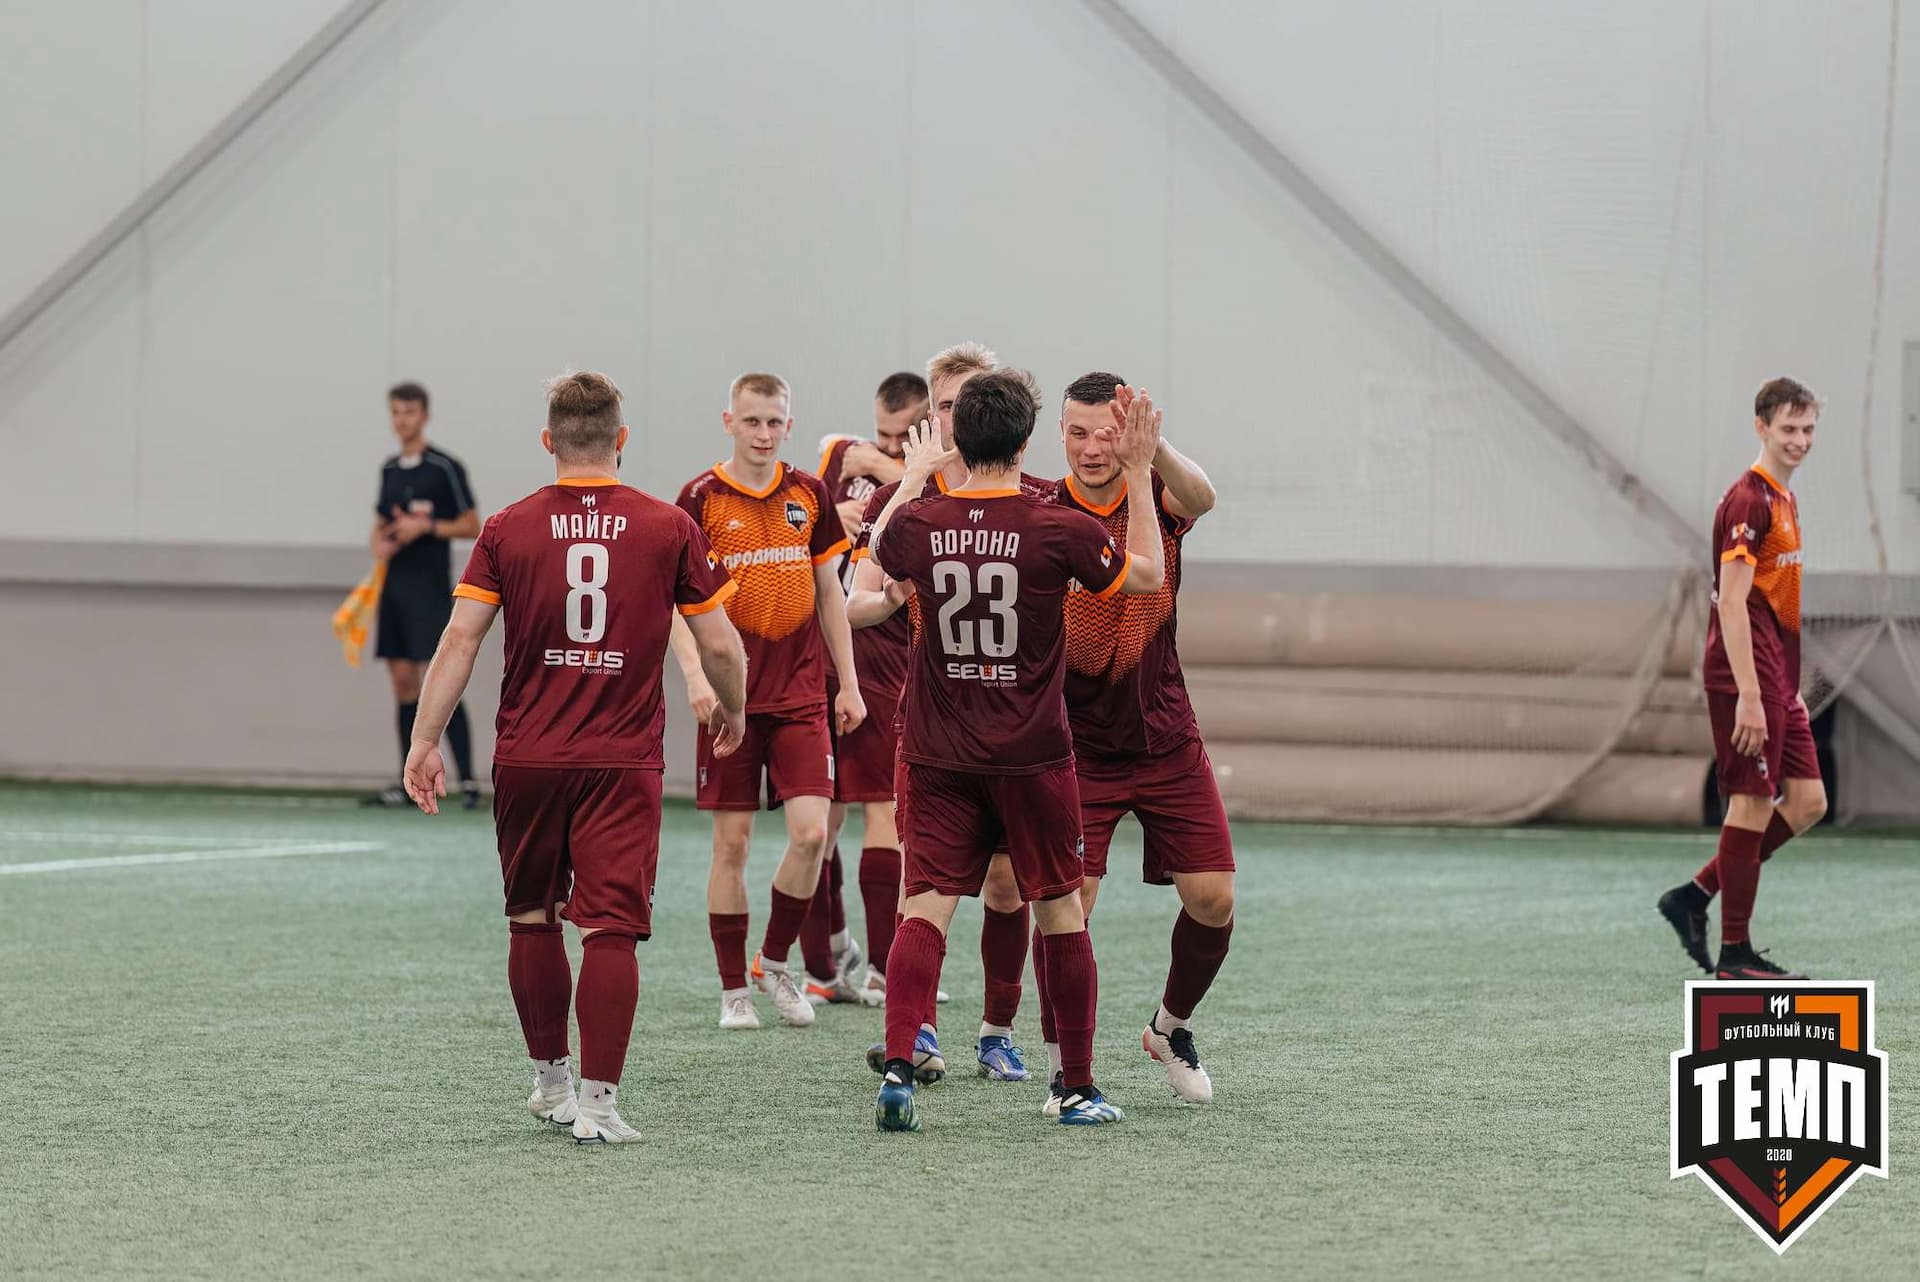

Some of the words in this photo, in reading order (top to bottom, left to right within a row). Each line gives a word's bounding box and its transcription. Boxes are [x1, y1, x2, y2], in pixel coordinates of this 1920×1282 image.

[551, 509, 627, 540] МАЙЕР
[930, 529, 1020, 558] ВОРОНА
[566, 543, 609, 643] 8
[932, 560, 1019, 657] 23
[544, 648, 624, 669] SEUS
[946, 662, 1017, 680] SEUS
[1000, 680, 1017, 688] Union
